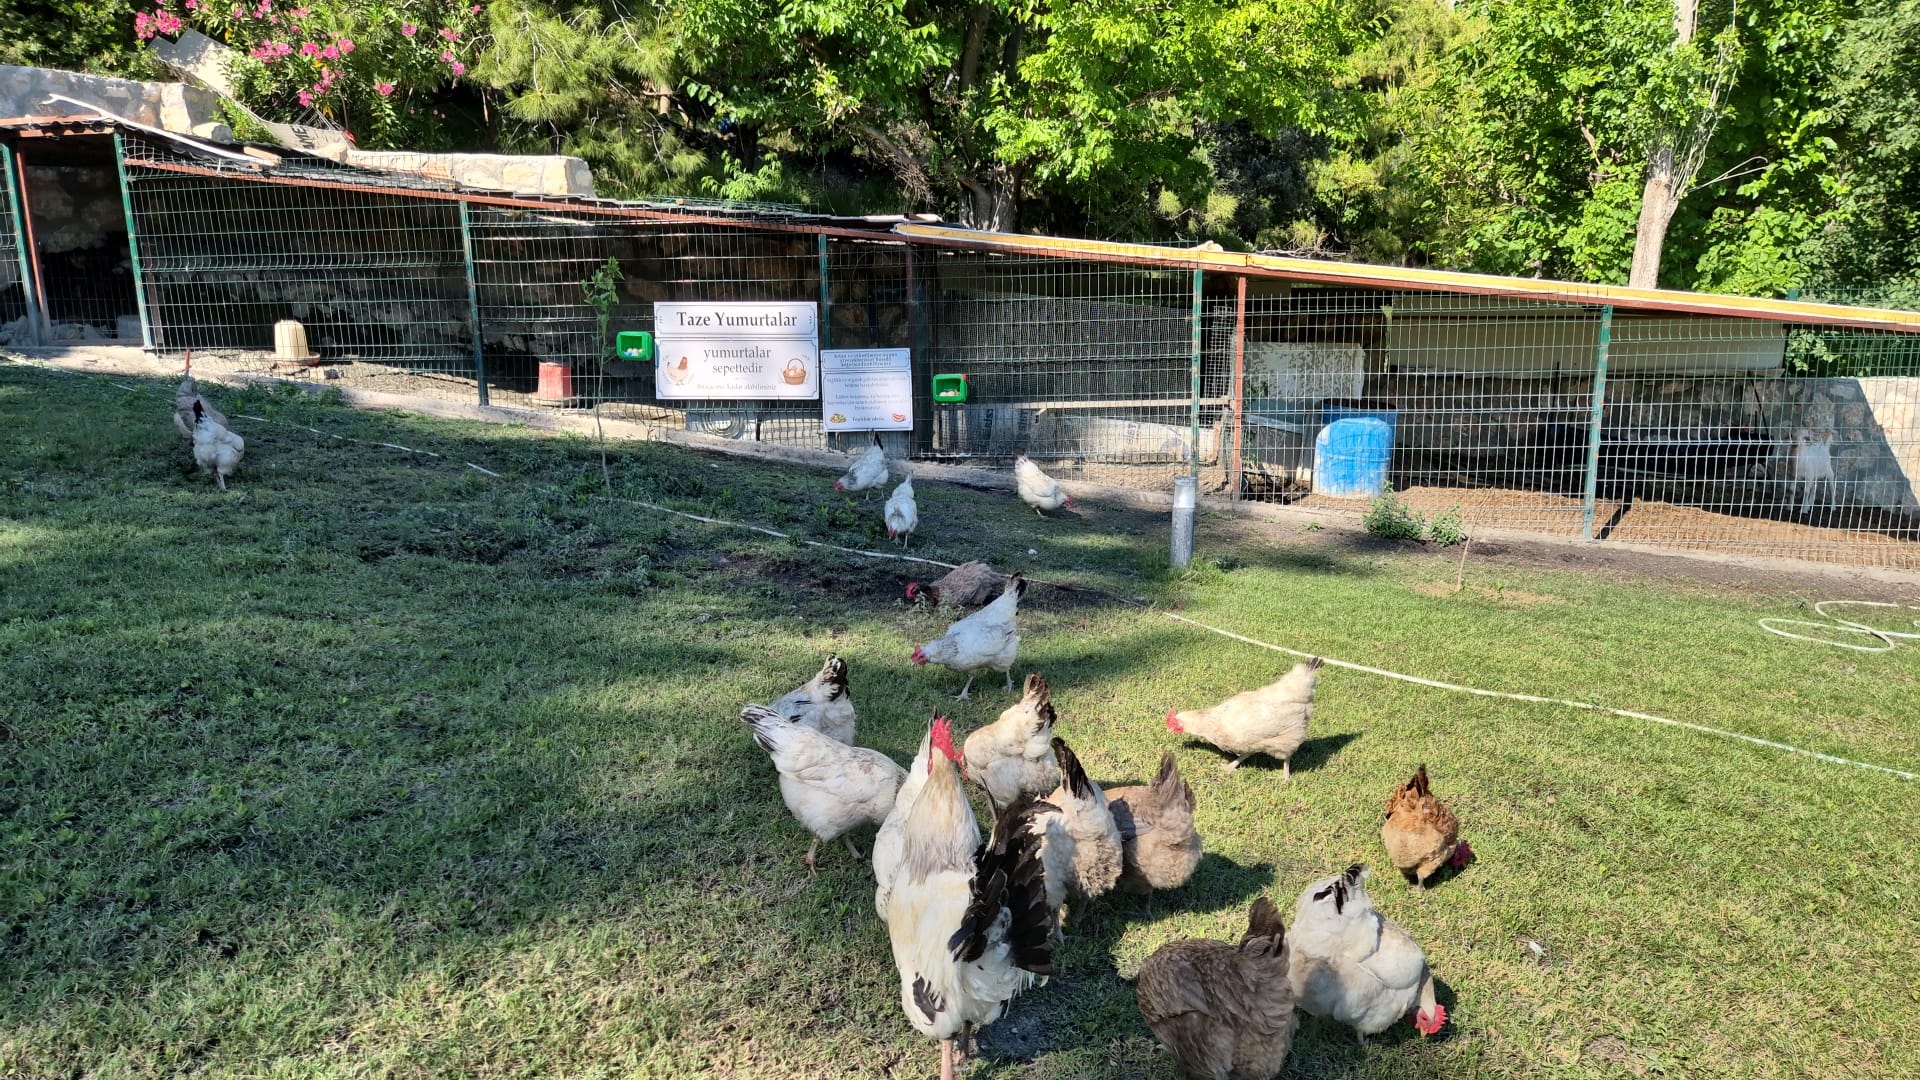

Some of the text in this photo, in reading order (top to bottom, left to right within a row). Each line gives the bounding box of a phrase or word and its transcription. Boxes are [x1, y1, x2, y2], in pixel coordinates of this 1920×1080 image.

[676, 311, 798, 327] Taze Yumurtalar
[703, 345, 771, 362] yumurtalar
[712, 362, 763, 376] sepettedir
